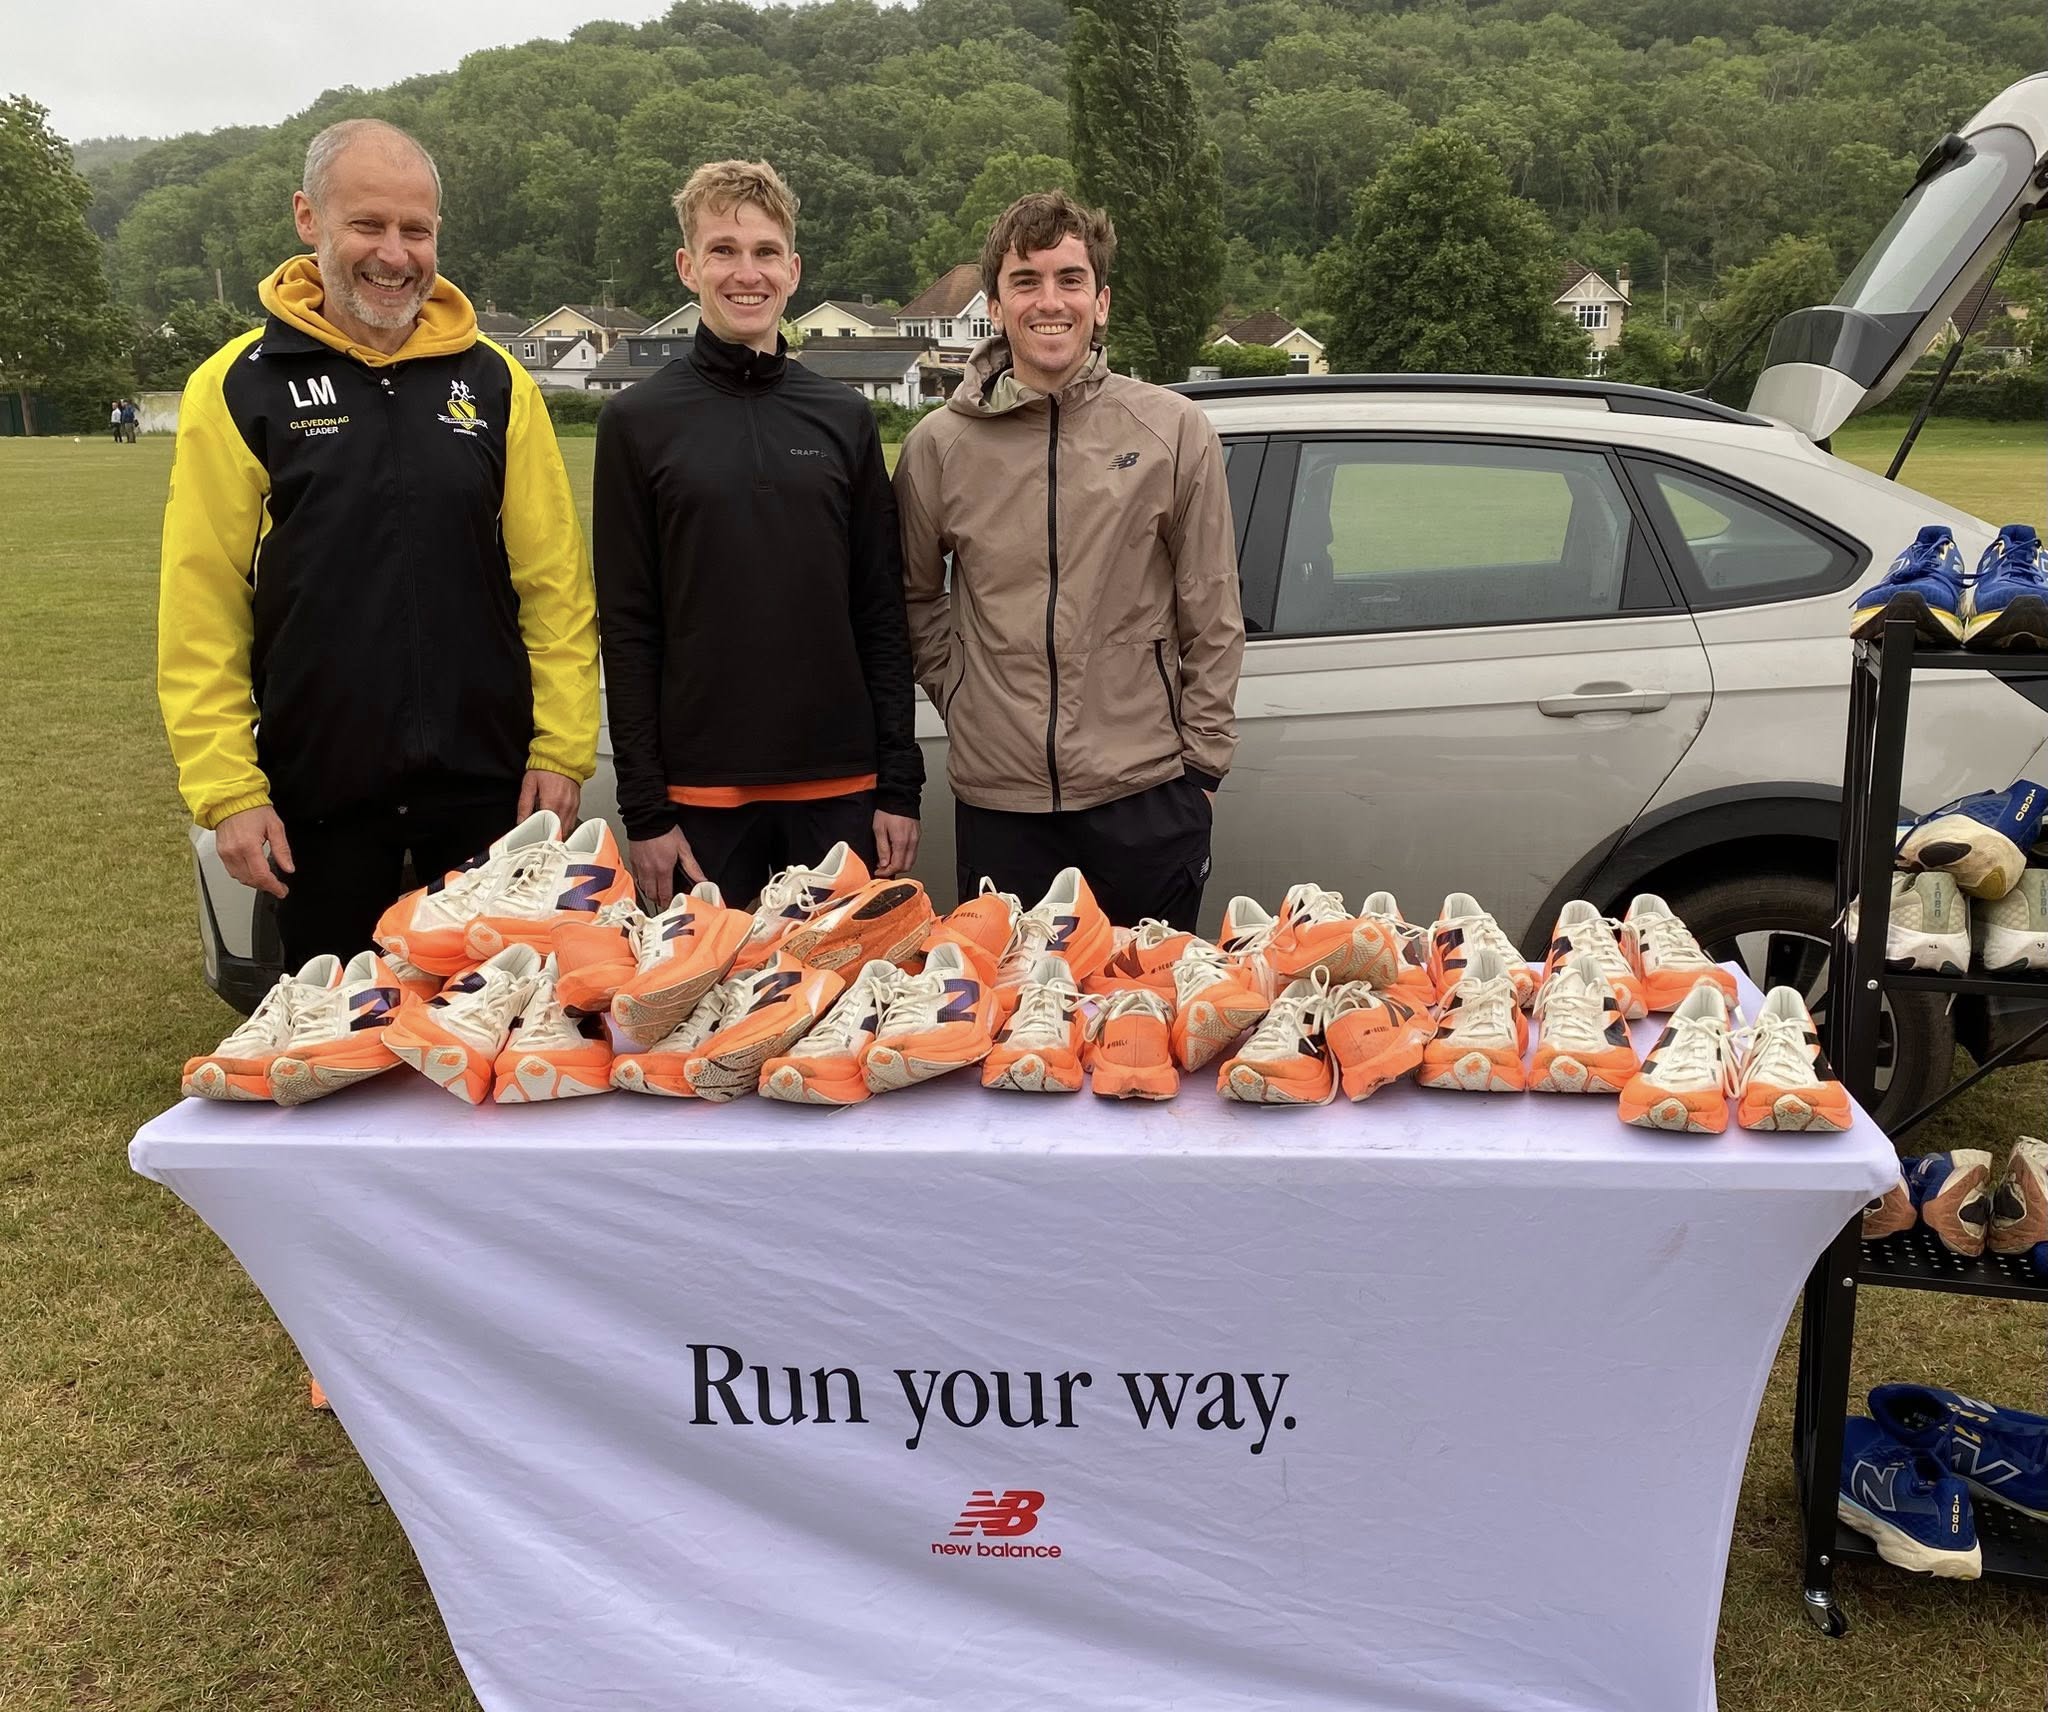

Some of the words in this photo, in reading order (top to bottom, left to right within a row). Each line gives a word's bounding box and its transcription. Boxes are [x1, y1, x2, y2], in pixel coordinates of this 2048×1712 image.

[288, 375, 337, 408] LM
[290, 418, 337, 430] CLEVEDON
[305, 426, 339, 437] LEADER
[790, 448, 820, 456] CRAFT
[2015, 788, 2037, 822] 1080
[1933, 882, 1942, 918] 1080
[686, 1344, 870, 1426] Run
[893, 1369, 1093, 1450] your
[1117, 1371, 1297, 1455] way.
[948, 1490, 1045, 1536] NB
[1951, 1493, 1961, 1534] 1080
[931, 1543, 972, 1556] new
[976, 1542, 1062, 1558] balance
